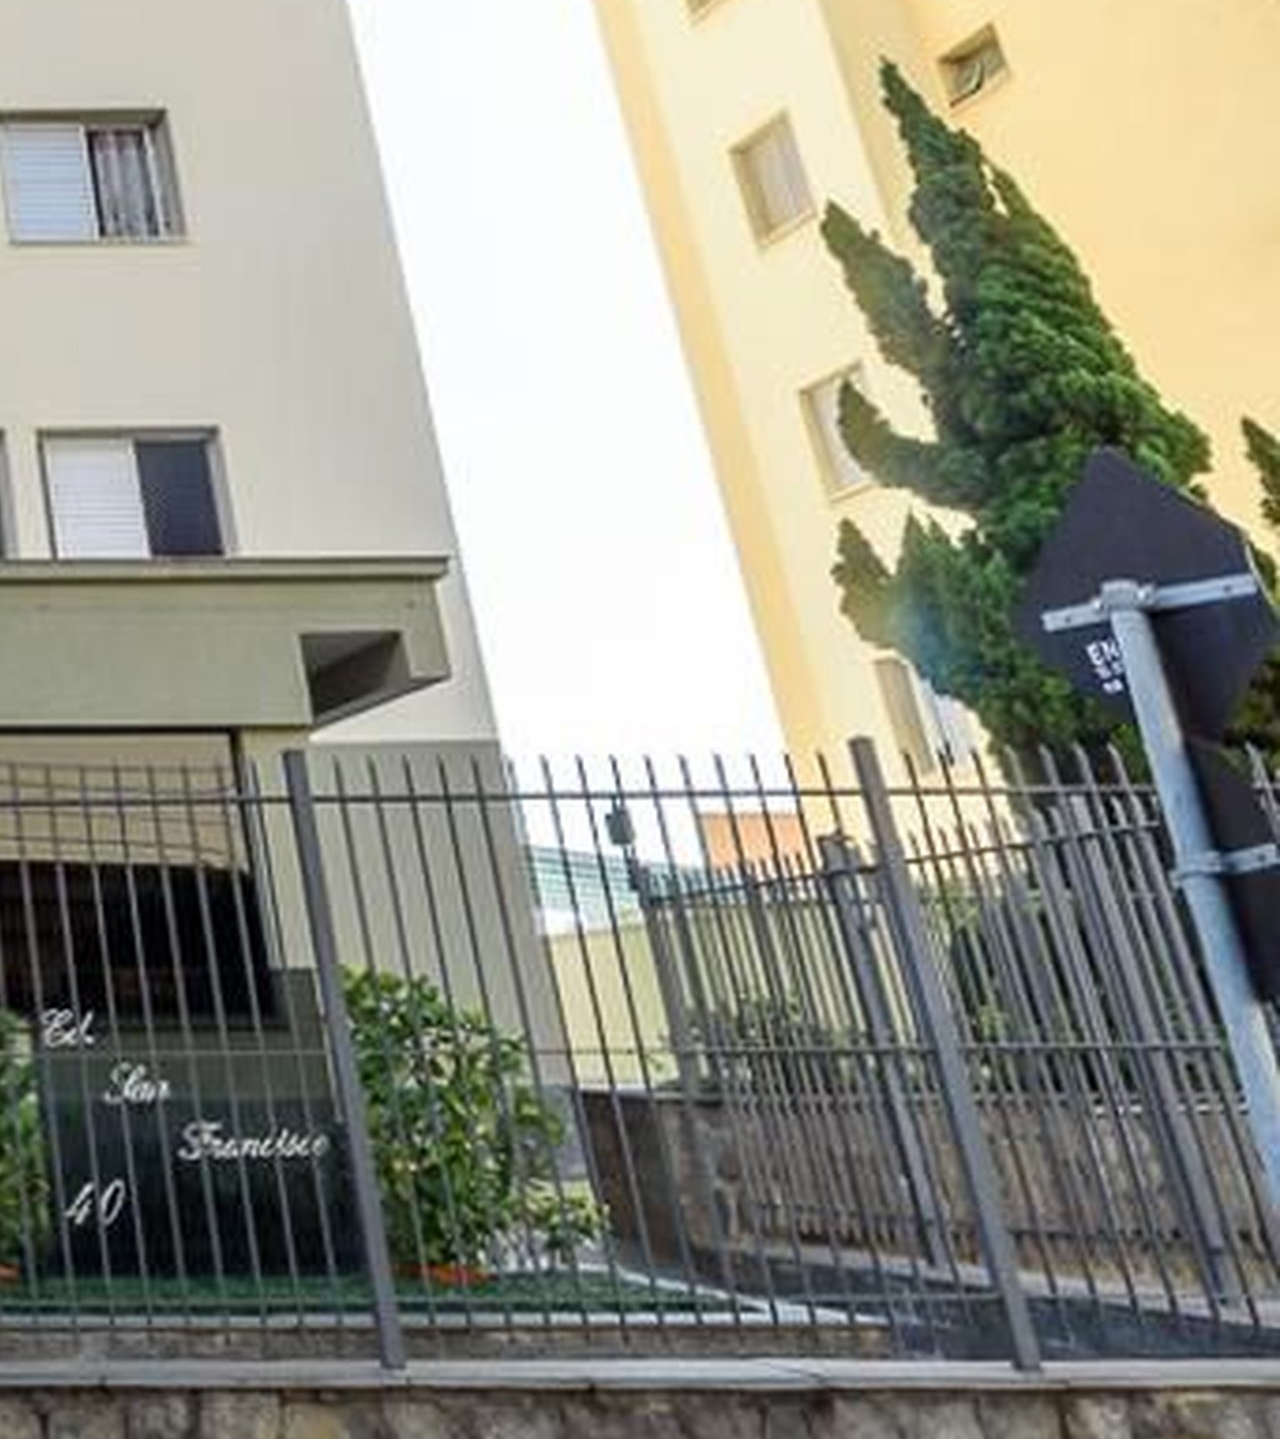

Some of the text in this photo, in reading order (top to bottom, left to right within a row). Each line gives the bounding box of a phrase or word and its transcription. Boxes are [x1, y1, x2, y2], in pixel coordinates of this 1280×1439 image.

[103, 1062, 171, 1104] San
[177, 1121, 330, 1161] Francisco
[65, 1179, 125, 1225] 40
